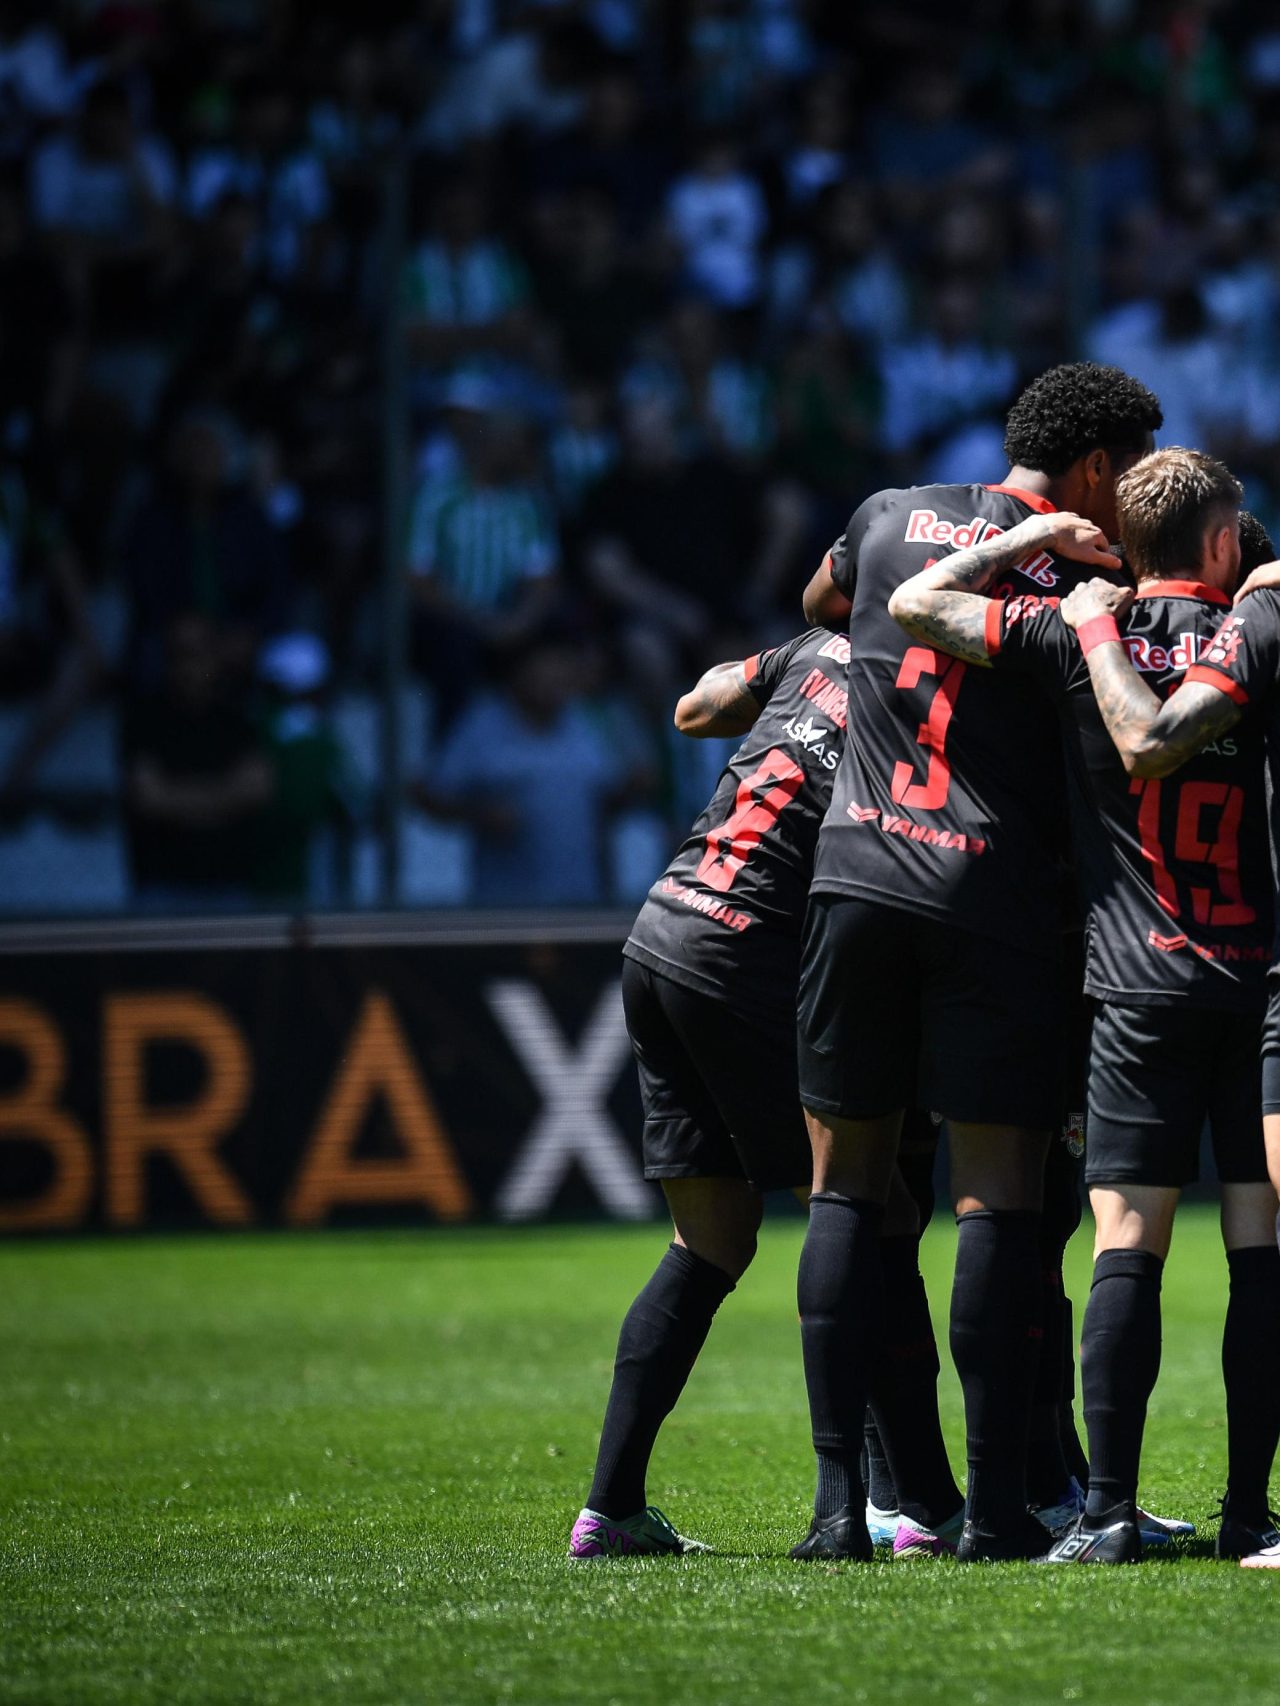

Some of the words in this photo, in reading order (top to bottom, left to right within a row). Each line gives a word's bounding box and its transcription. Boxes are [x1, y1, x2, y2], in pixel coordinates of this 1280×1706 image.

[819, 634, 851, 664] Re
[1121, 632, 1196, 672] Red
[890, 647, 966, 811] 3
[696, 747, 807, 893] 8
[1127, 776, 1257, 927] 19
